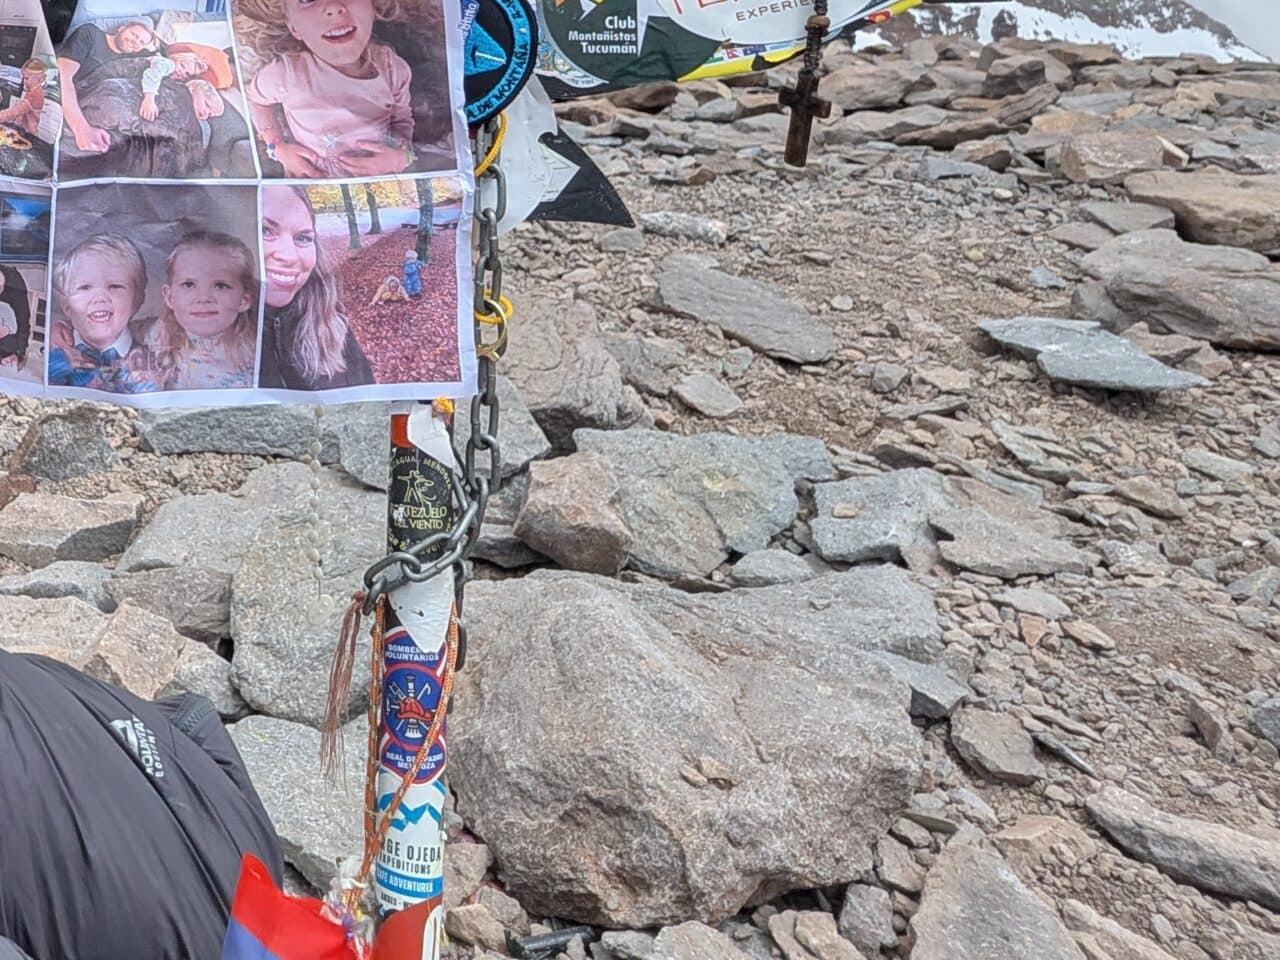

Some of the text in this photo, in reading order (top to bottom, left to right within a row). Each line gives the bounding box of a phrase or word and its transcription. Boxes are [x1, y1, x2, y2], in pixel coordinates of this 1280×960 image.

[605, 16, 636, 29] Club
[568, 30, 636, 41] Montañistas
[581, 41, 637, 54] Tucumán
[409, 519, 443, 529] VIENTO
[386, 751, 404, 761] REAL
[407, 845, 441, 863] OJEDA
